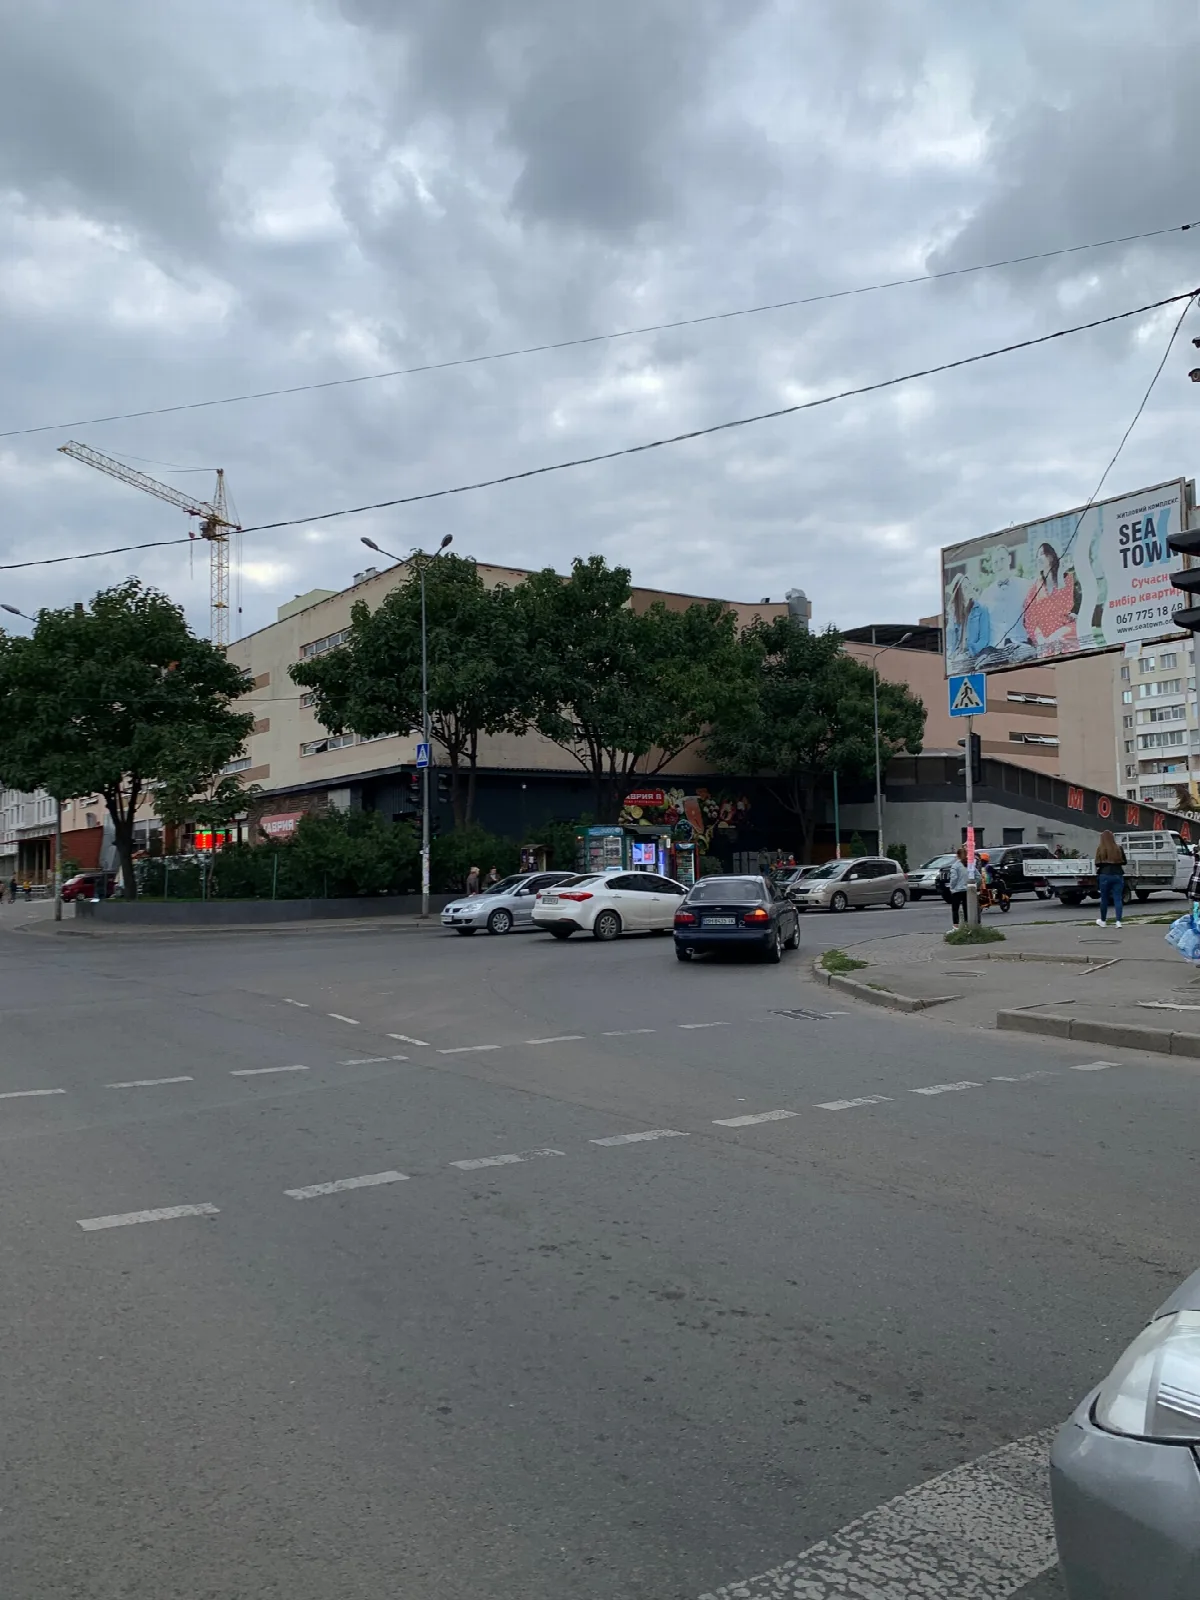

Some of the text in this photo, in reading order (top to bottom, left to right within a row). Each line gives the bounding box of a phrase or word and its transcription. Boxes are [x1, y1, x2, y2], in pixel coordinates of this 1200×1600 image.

[1147, 497, 1178, 511] КОМПЛЕКС
[1118, 517, 1156, 546] SEA
[1109, 594, 1137, 609] вибір
[1116, 613, 1133, 624] 067
[1135, 608, 1154, 621] 775
[1156, 605, 1169, 617] 18
